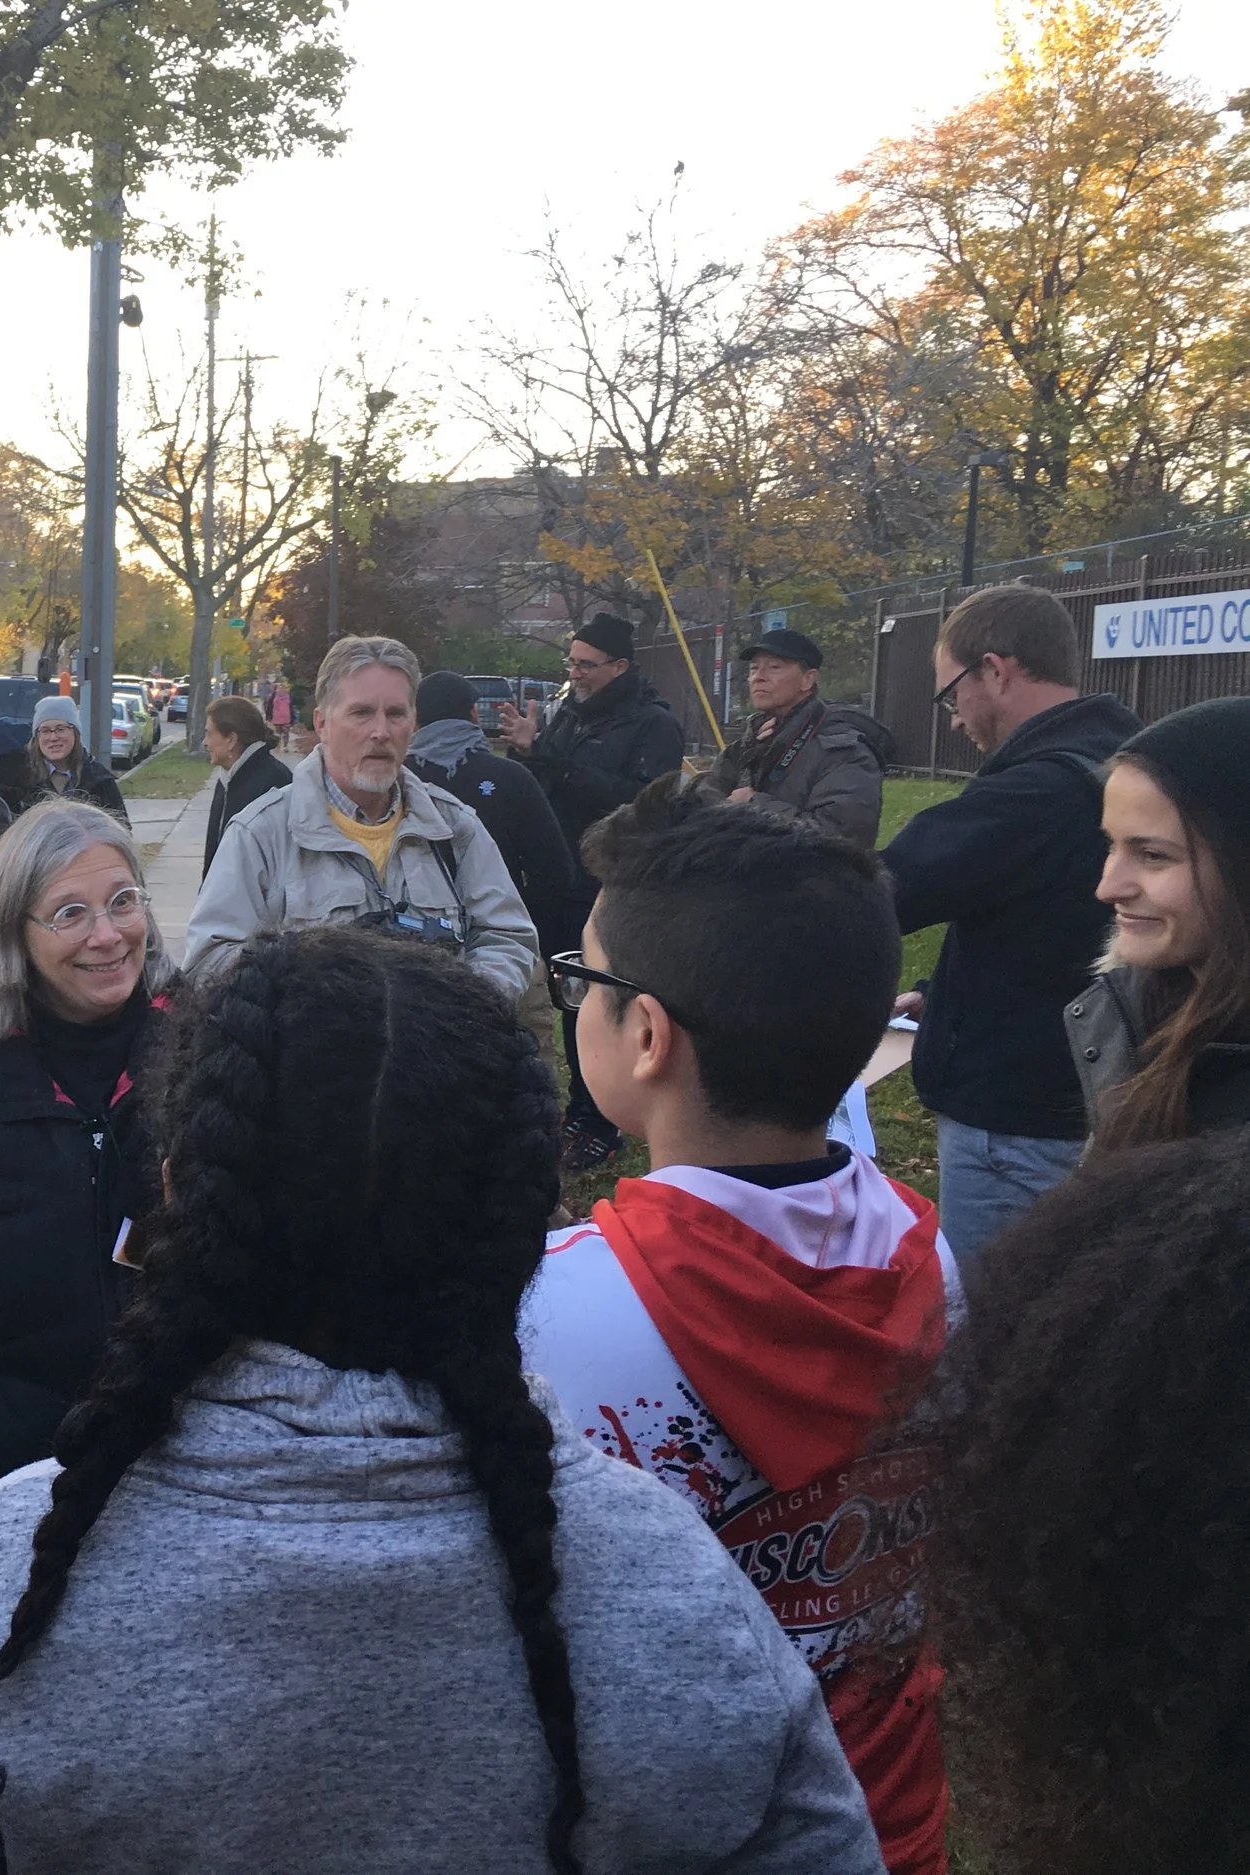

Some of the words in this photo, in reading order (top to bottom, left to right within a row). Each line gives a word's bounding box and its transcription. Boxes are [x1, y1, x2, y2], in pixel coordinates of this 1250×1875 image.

[1132, 604, 1214, 649] UNITED
[756, 1482, 823, 1527] HIGH
[769, 1594, 841, 1620] LING
